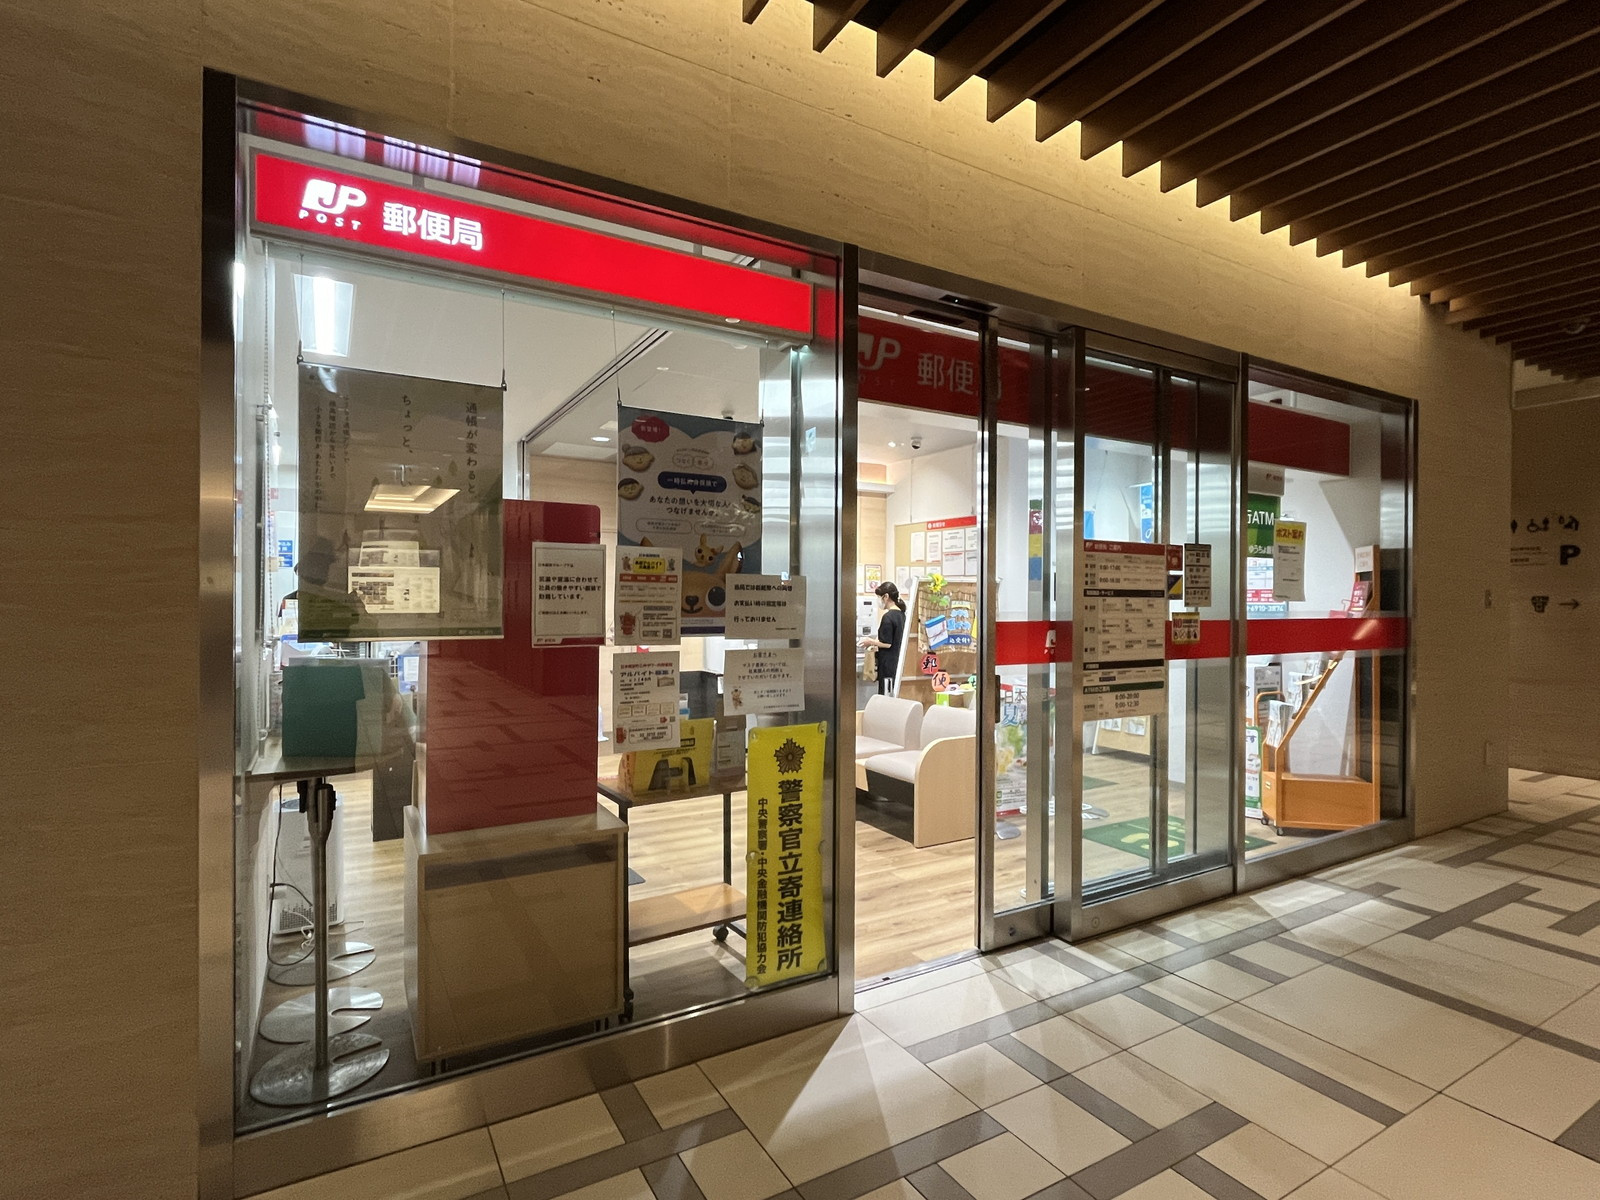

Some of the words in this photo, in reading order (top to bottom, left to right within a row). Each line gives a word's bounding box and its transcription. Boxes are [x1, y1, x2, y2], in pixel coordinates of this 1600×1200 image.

[299, 209, 362, 231] POST
[382, 202, 484, 252] 郵便局
[401, 394, 414, 454] ちょっと、
[1560, 544, 1581, 566] P
[756, 797, 768, 975] 中央警察署・中央金融機関防犯協力会
[776, 779, 804, 971] 警察官立寄連絡所
